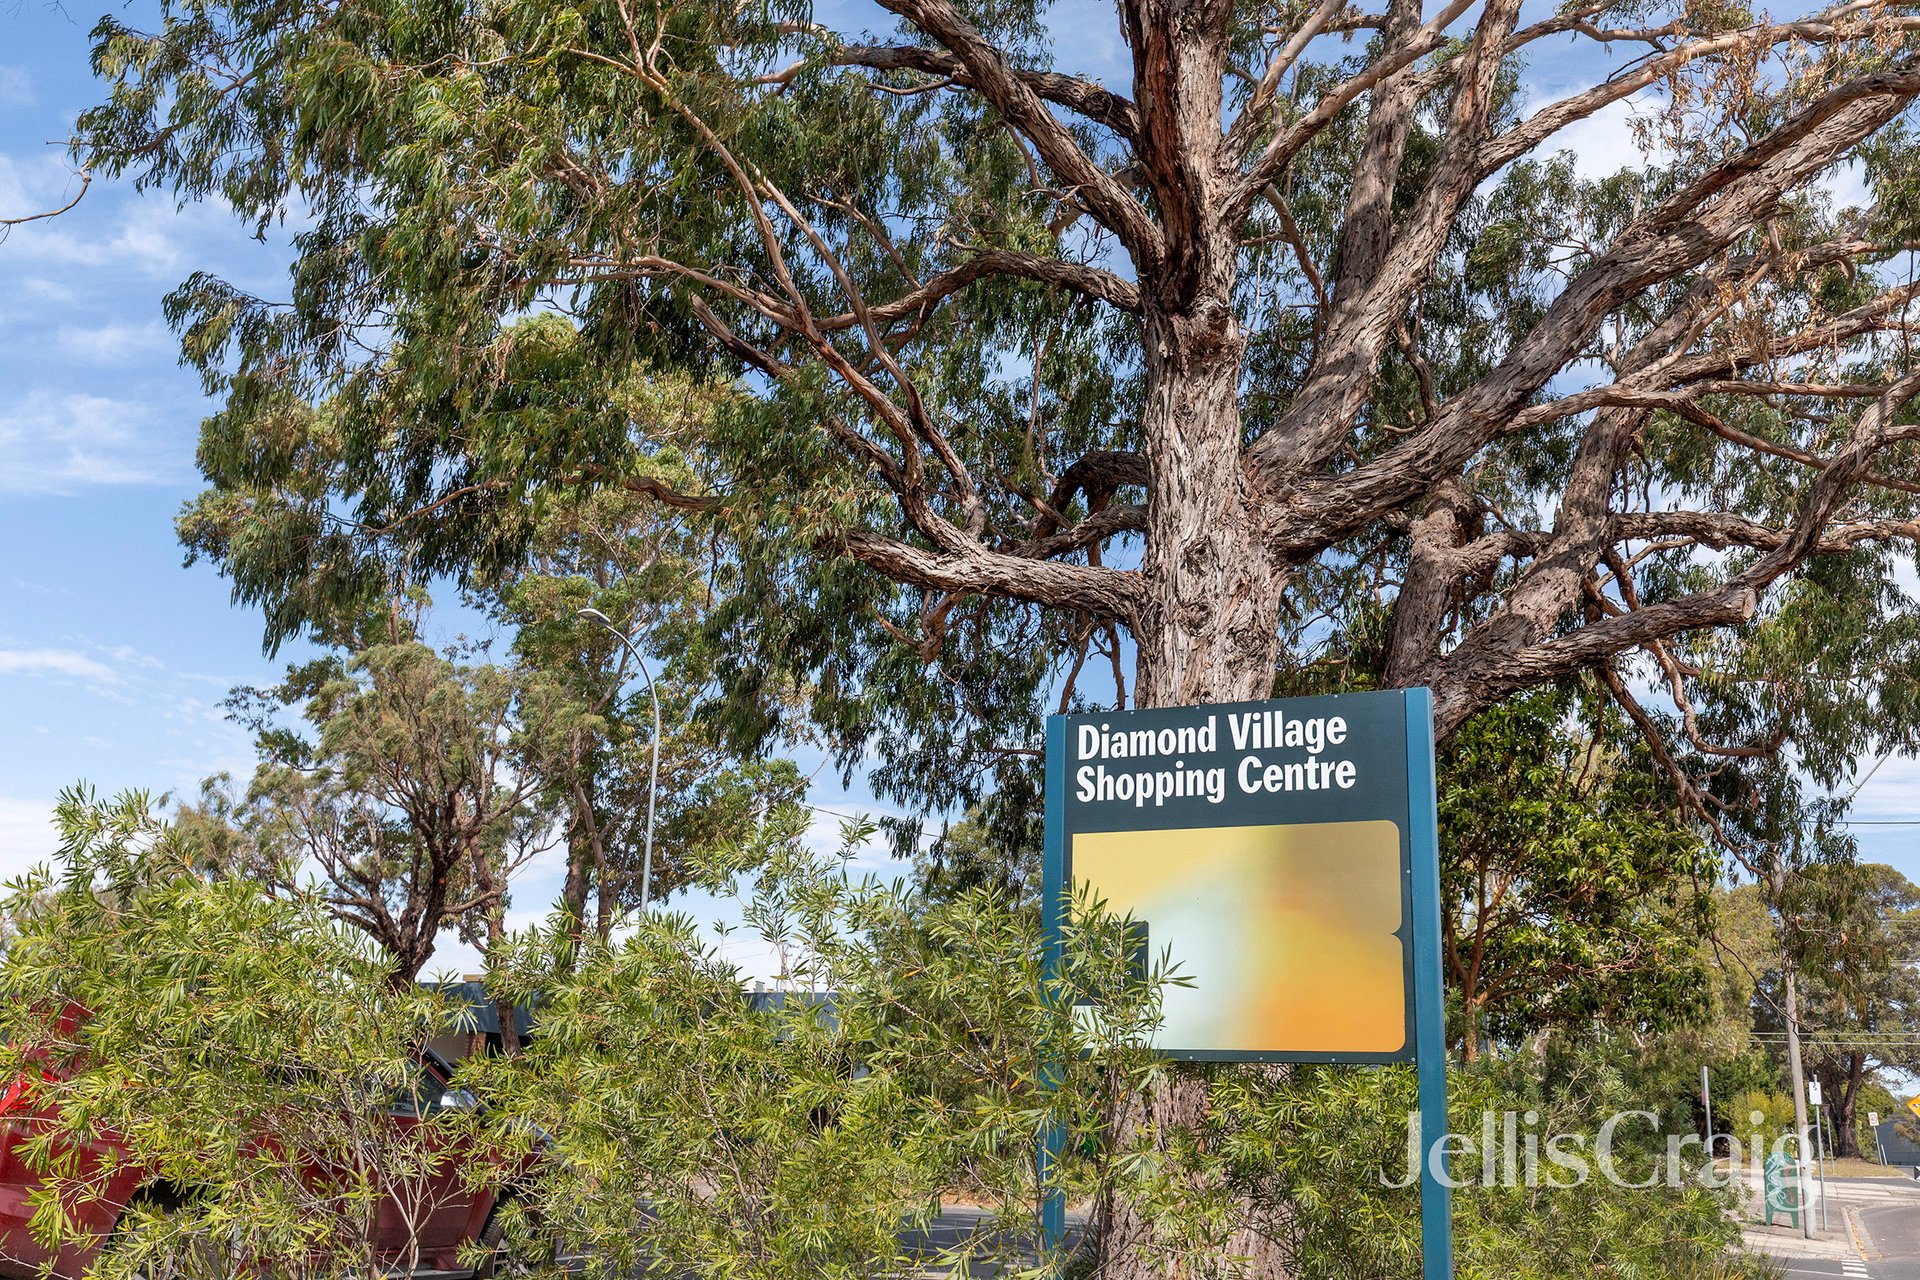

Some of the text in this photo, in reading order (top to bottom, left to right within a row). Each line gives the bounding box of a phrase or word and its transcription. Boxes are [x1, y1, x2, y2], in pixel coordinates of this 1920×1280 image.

[1078, 710, 1347, 760] Diamond Village
[1076, 756, 1357, 808] Shopping Centre
